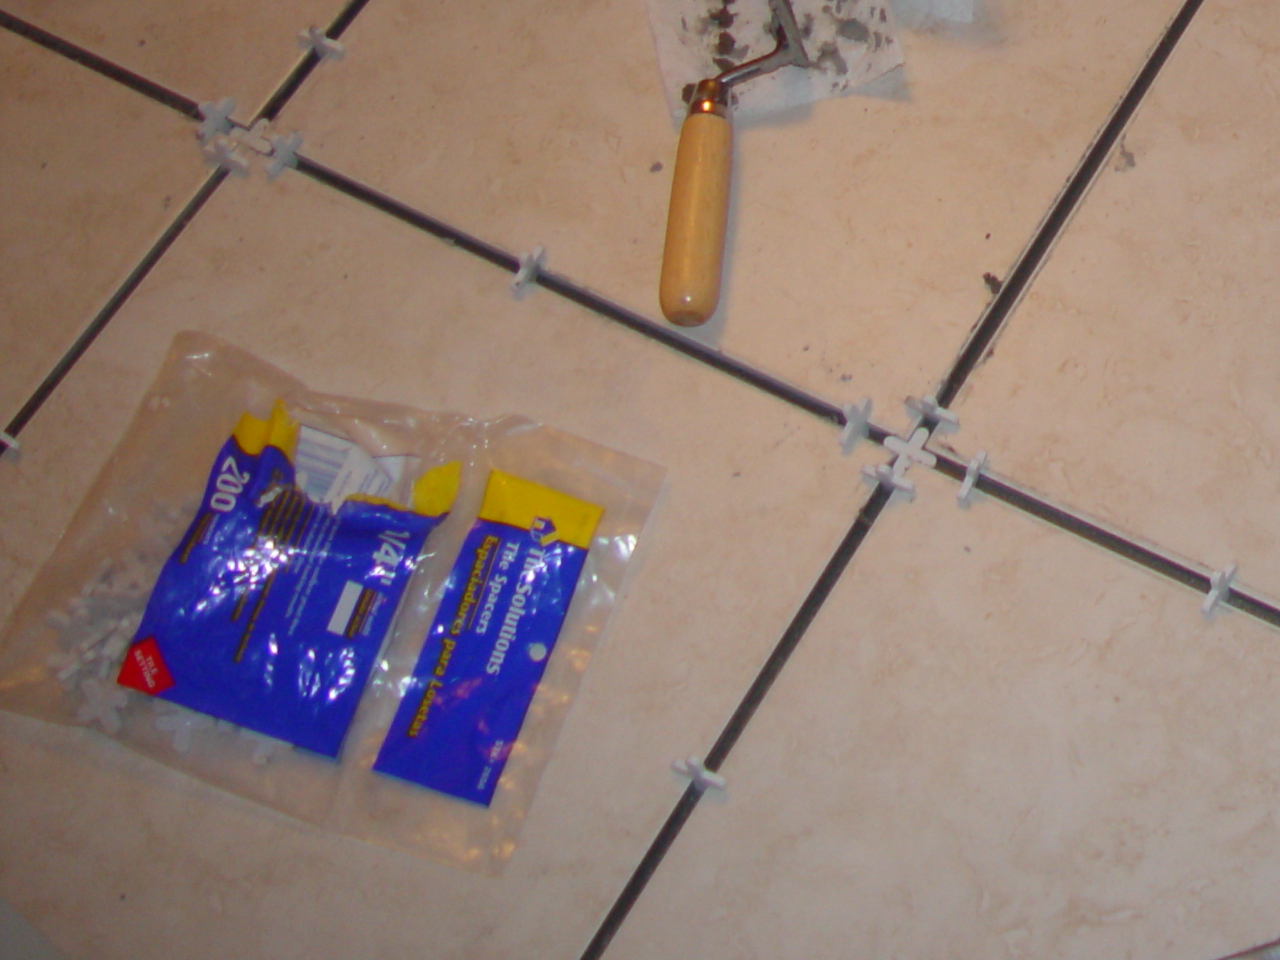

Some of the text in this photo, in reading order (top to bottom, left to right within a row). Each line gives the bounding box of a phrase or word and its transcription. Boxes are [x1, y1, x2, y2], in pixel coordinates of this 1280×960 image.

[209, 455, 250, 512] 200
[473, 540, 519, 635] Tile Spacers
[134, 649, 158, 687] TILE SETTING
[407, 533, 498, 739] Espaciadores para Losetas
